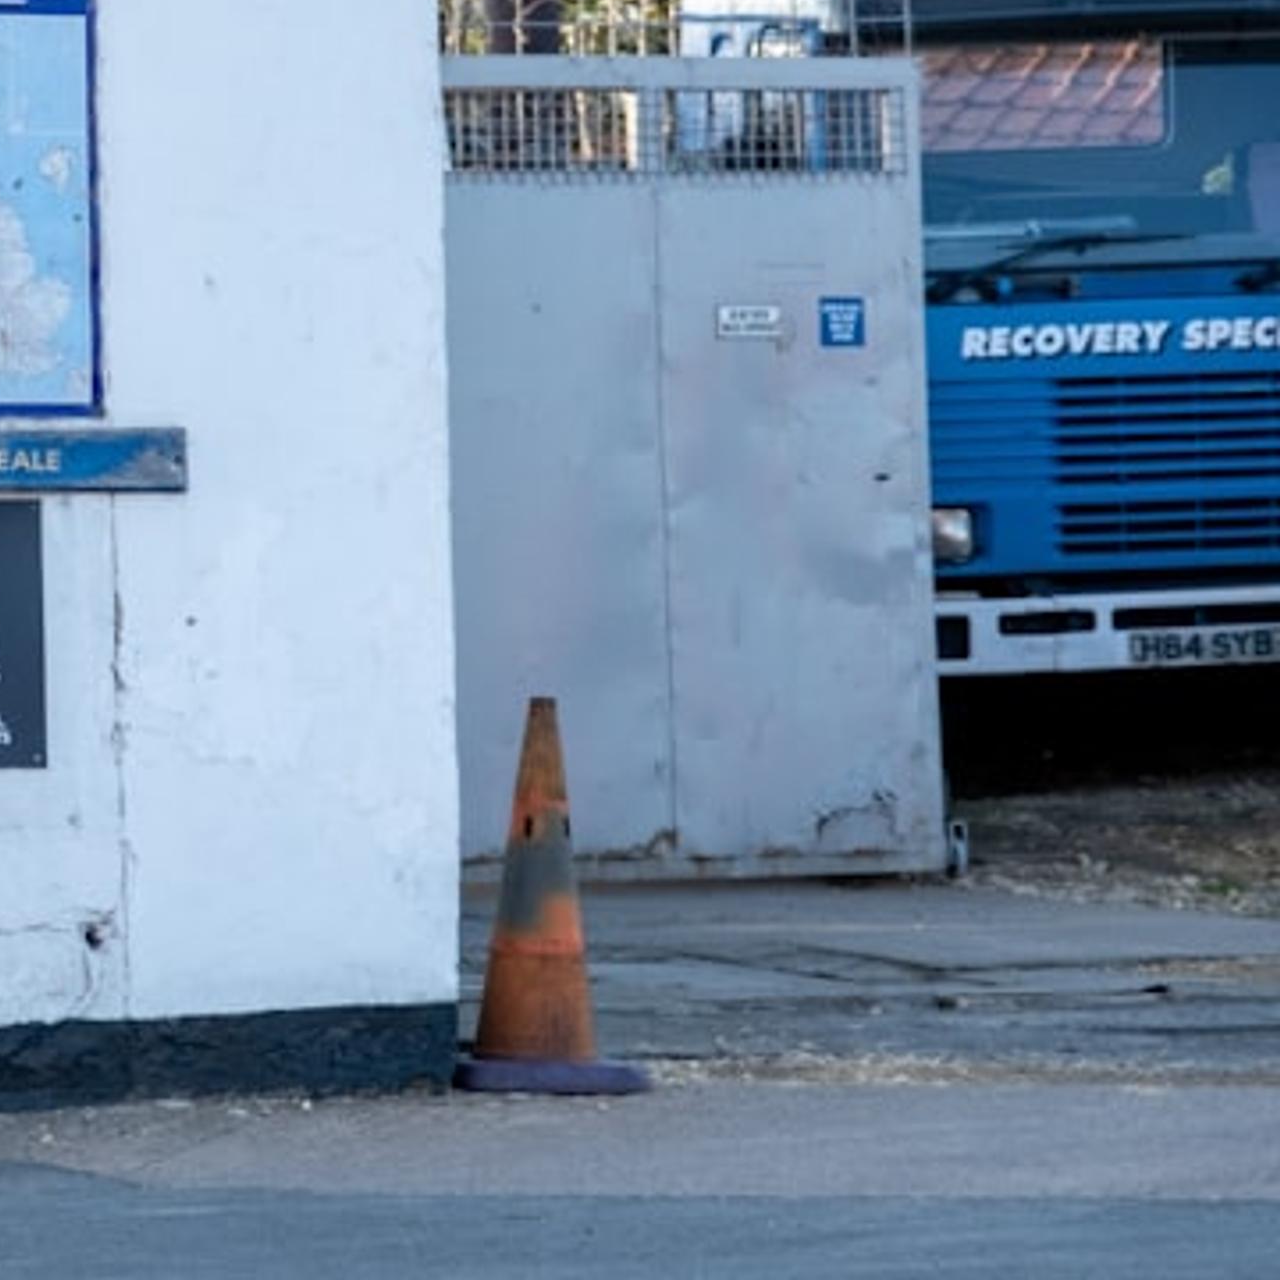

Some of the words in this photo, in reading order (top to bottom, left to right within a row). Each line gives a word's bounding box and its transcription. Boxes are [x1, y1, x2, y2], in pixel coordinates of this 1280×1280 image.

[962, 322, 1170, 357] RECOVERY
[1182, 318, 1280, 349] SPEC
[1211, 628, 1272, 659] SYB
